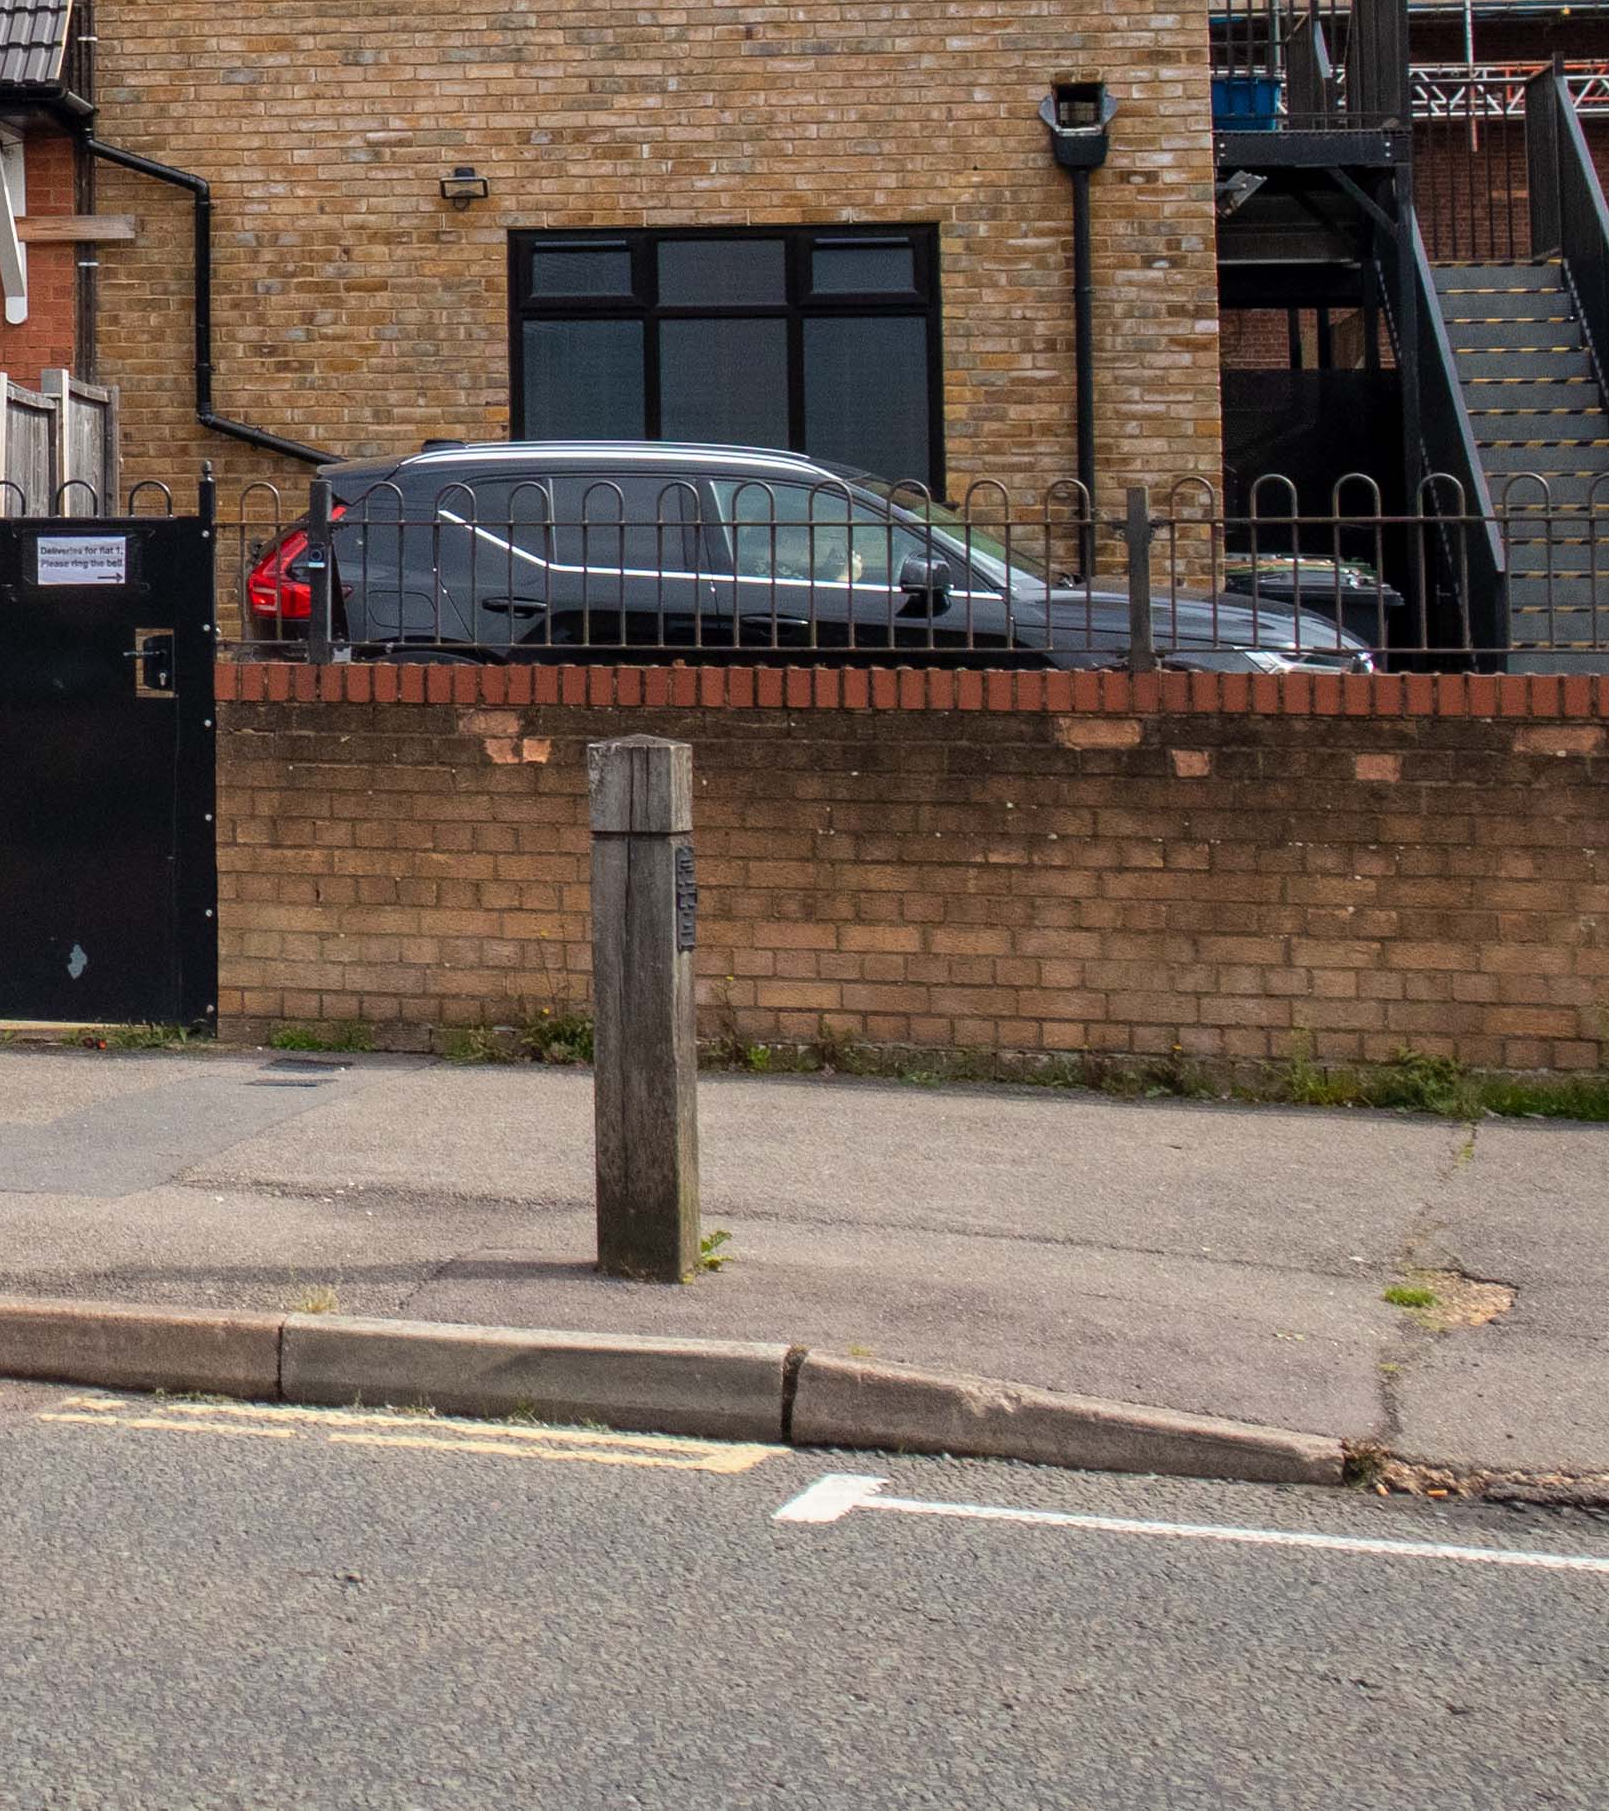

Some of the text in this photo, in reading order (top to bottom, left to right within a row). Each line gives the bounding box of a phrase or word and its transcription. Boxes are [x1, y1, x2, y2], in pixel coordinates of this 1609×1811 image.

[85, 546, 97, 555] for
[41, 559, 69, 568] Please
[71, 559, 88, 569] ring
[91, 559, 104, 567] the
